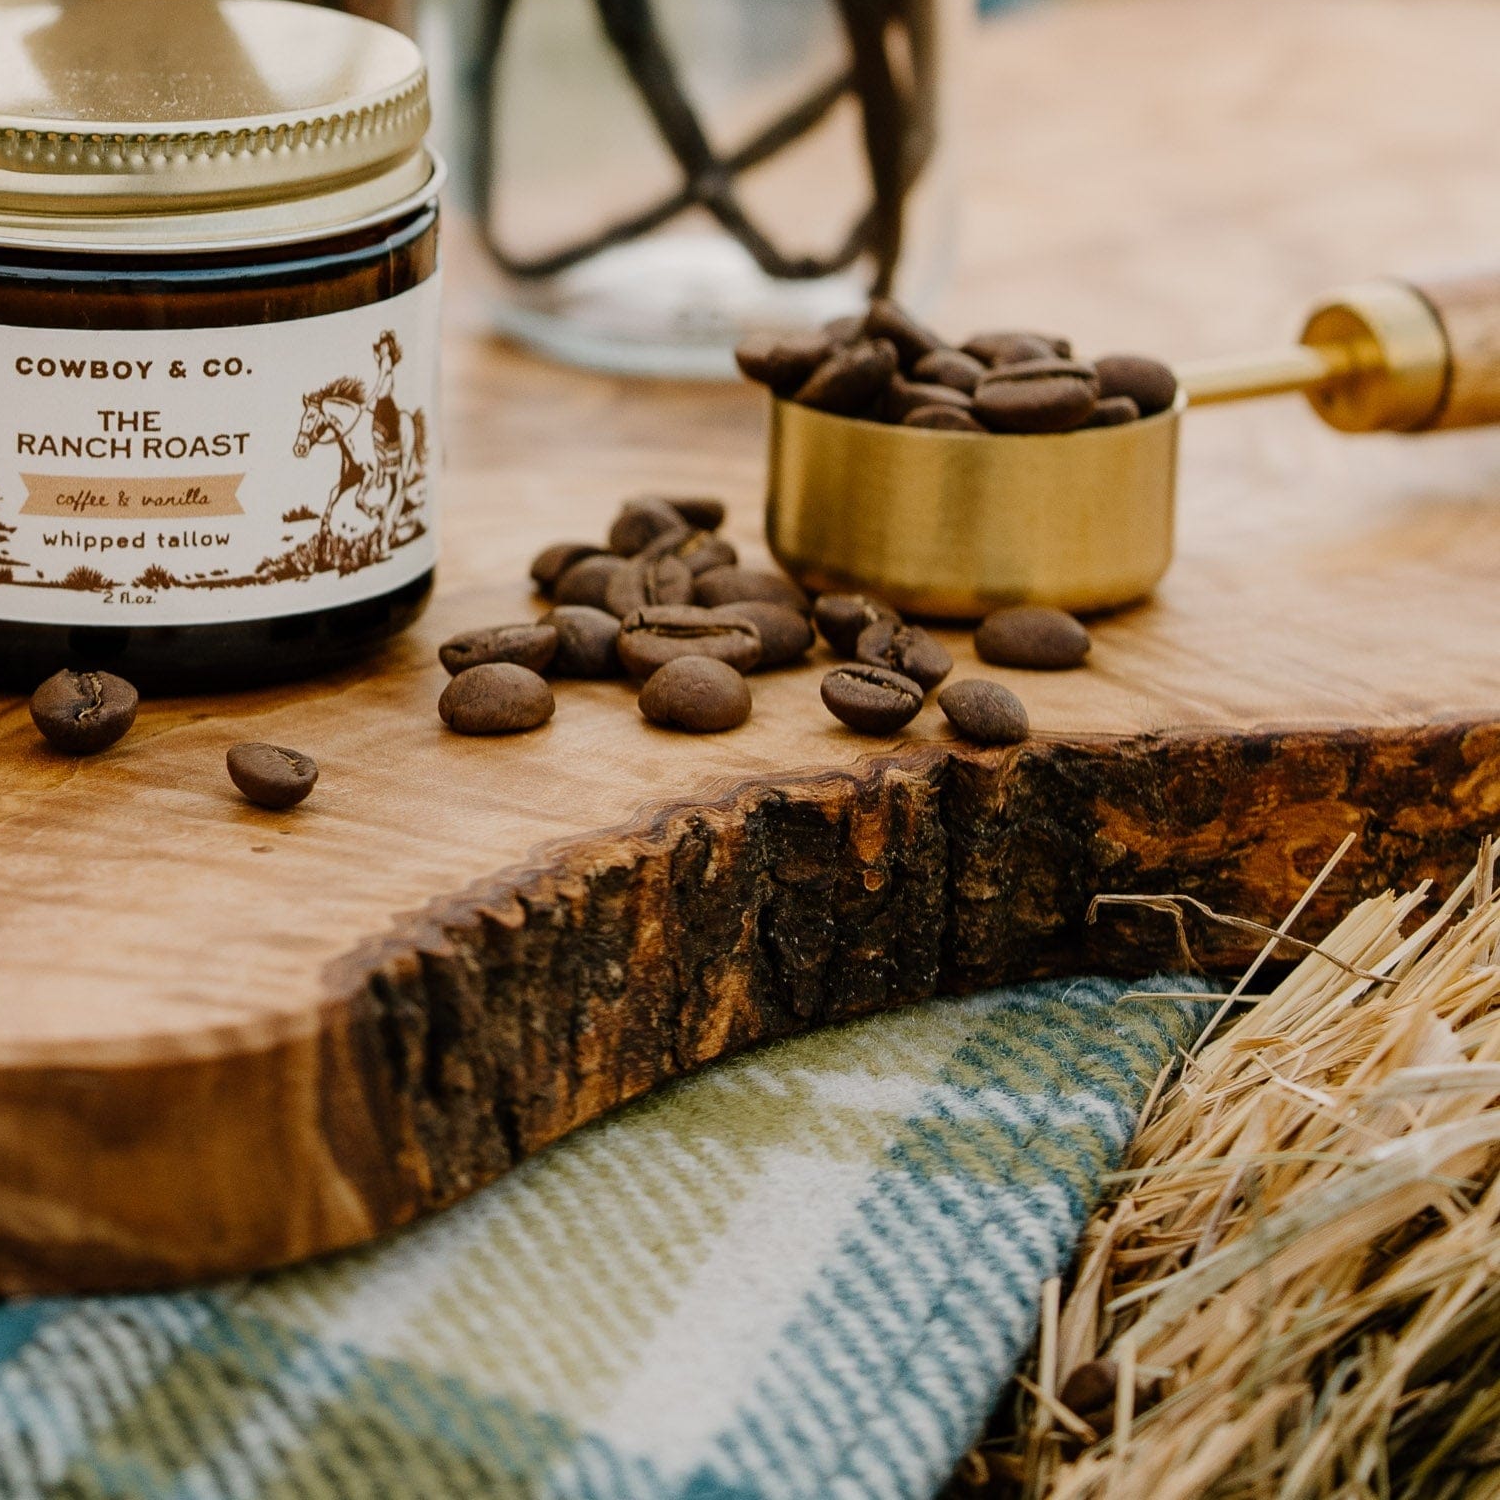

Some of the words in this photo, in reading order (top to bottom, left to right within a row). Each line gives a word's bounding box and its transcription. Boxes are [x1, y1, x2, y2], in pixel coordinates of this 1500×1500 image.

[15, 356, 153, 380] COWBOY
[169, 360, 187, 379] &
[203, 357, 253, 377] CO.
[97, 410, 161, 432] THE
[17, 433, 132, 459] RANCH
[143, 433, 251, 459] ROAST
[55, 489, 110, 512] coffee
[117, 489, 130, 508] &
[141, 487, 211, 507] vanilla
[43, 530, 146, 552] whipped
[156, 530, 230, 549] tallow
[103, 590, 114, 604] 2
